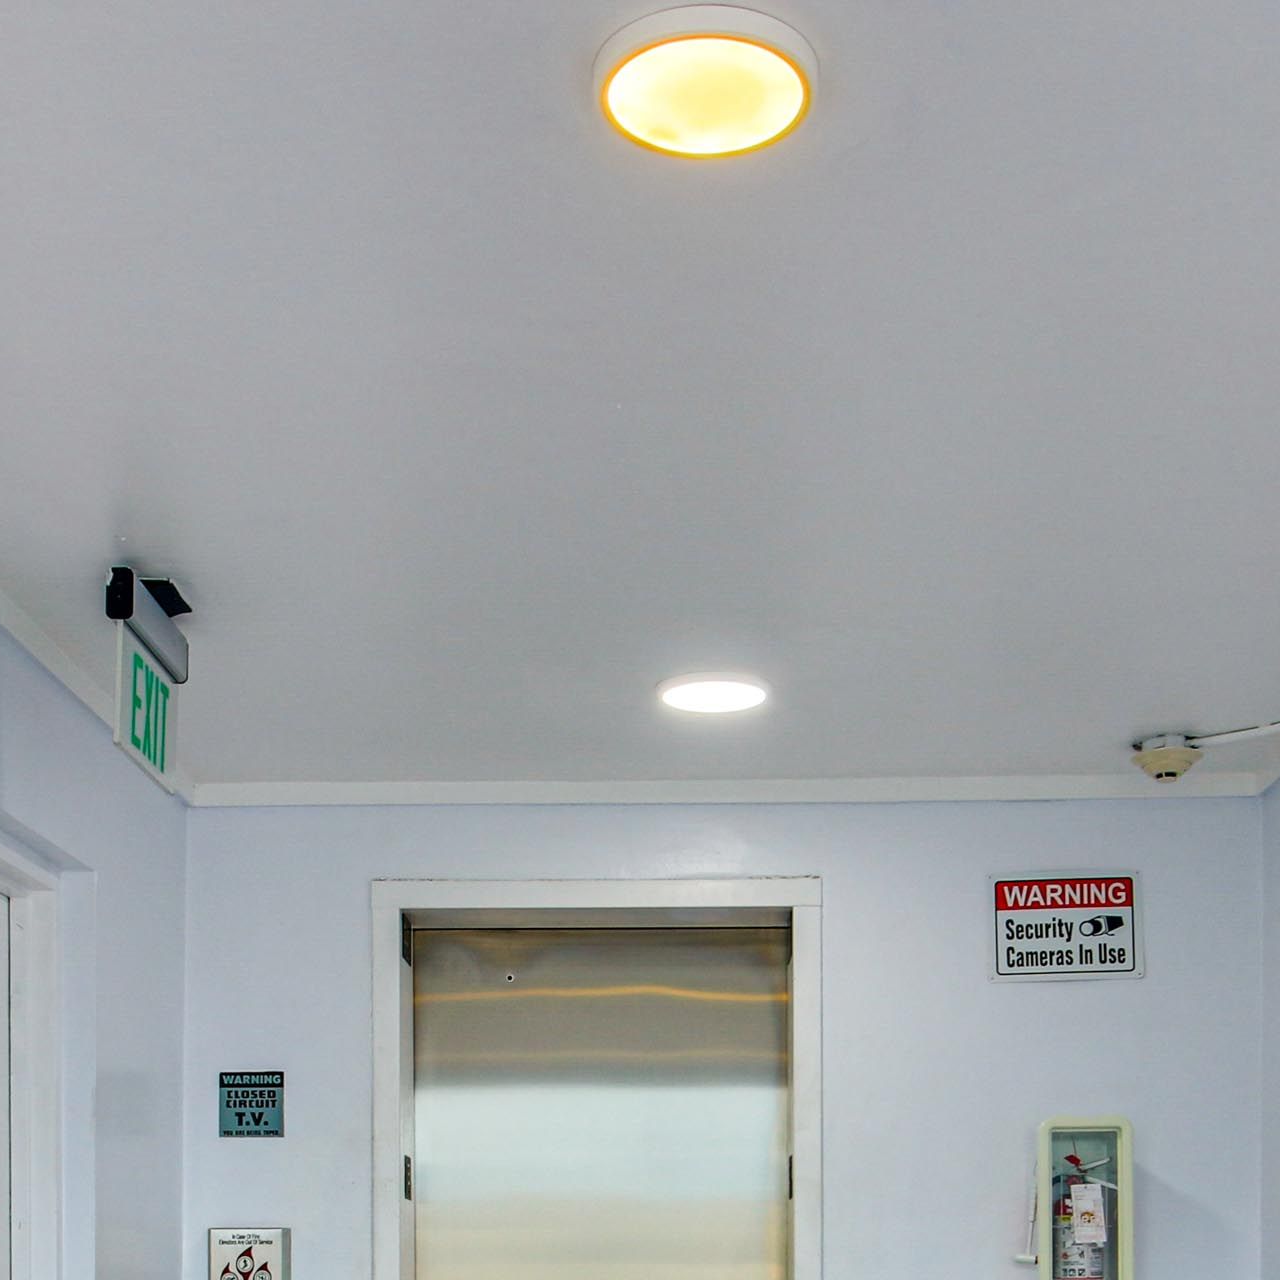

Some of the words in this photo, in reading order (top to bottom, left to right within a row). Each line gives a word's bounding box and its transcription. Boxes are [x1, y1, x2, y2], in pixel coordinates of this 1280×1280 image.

[131, 651, 169, 773] EXIT
[1003, 882, 1126, 907] WARNING
[1005, 917, 1073, 942] Security
[1006, 946, 1073, 968] Cameras
[1079, 944, 1093, 965] In
[1099, 943, 1126, 964] Use
[222, 1075, 281, 1084] WARNING
[226, 1099, 277, 1108] CIRCUIT
[227, 1090, 276, 1099] CLOSED
[235, 1112, 269, 1126] T.V.
